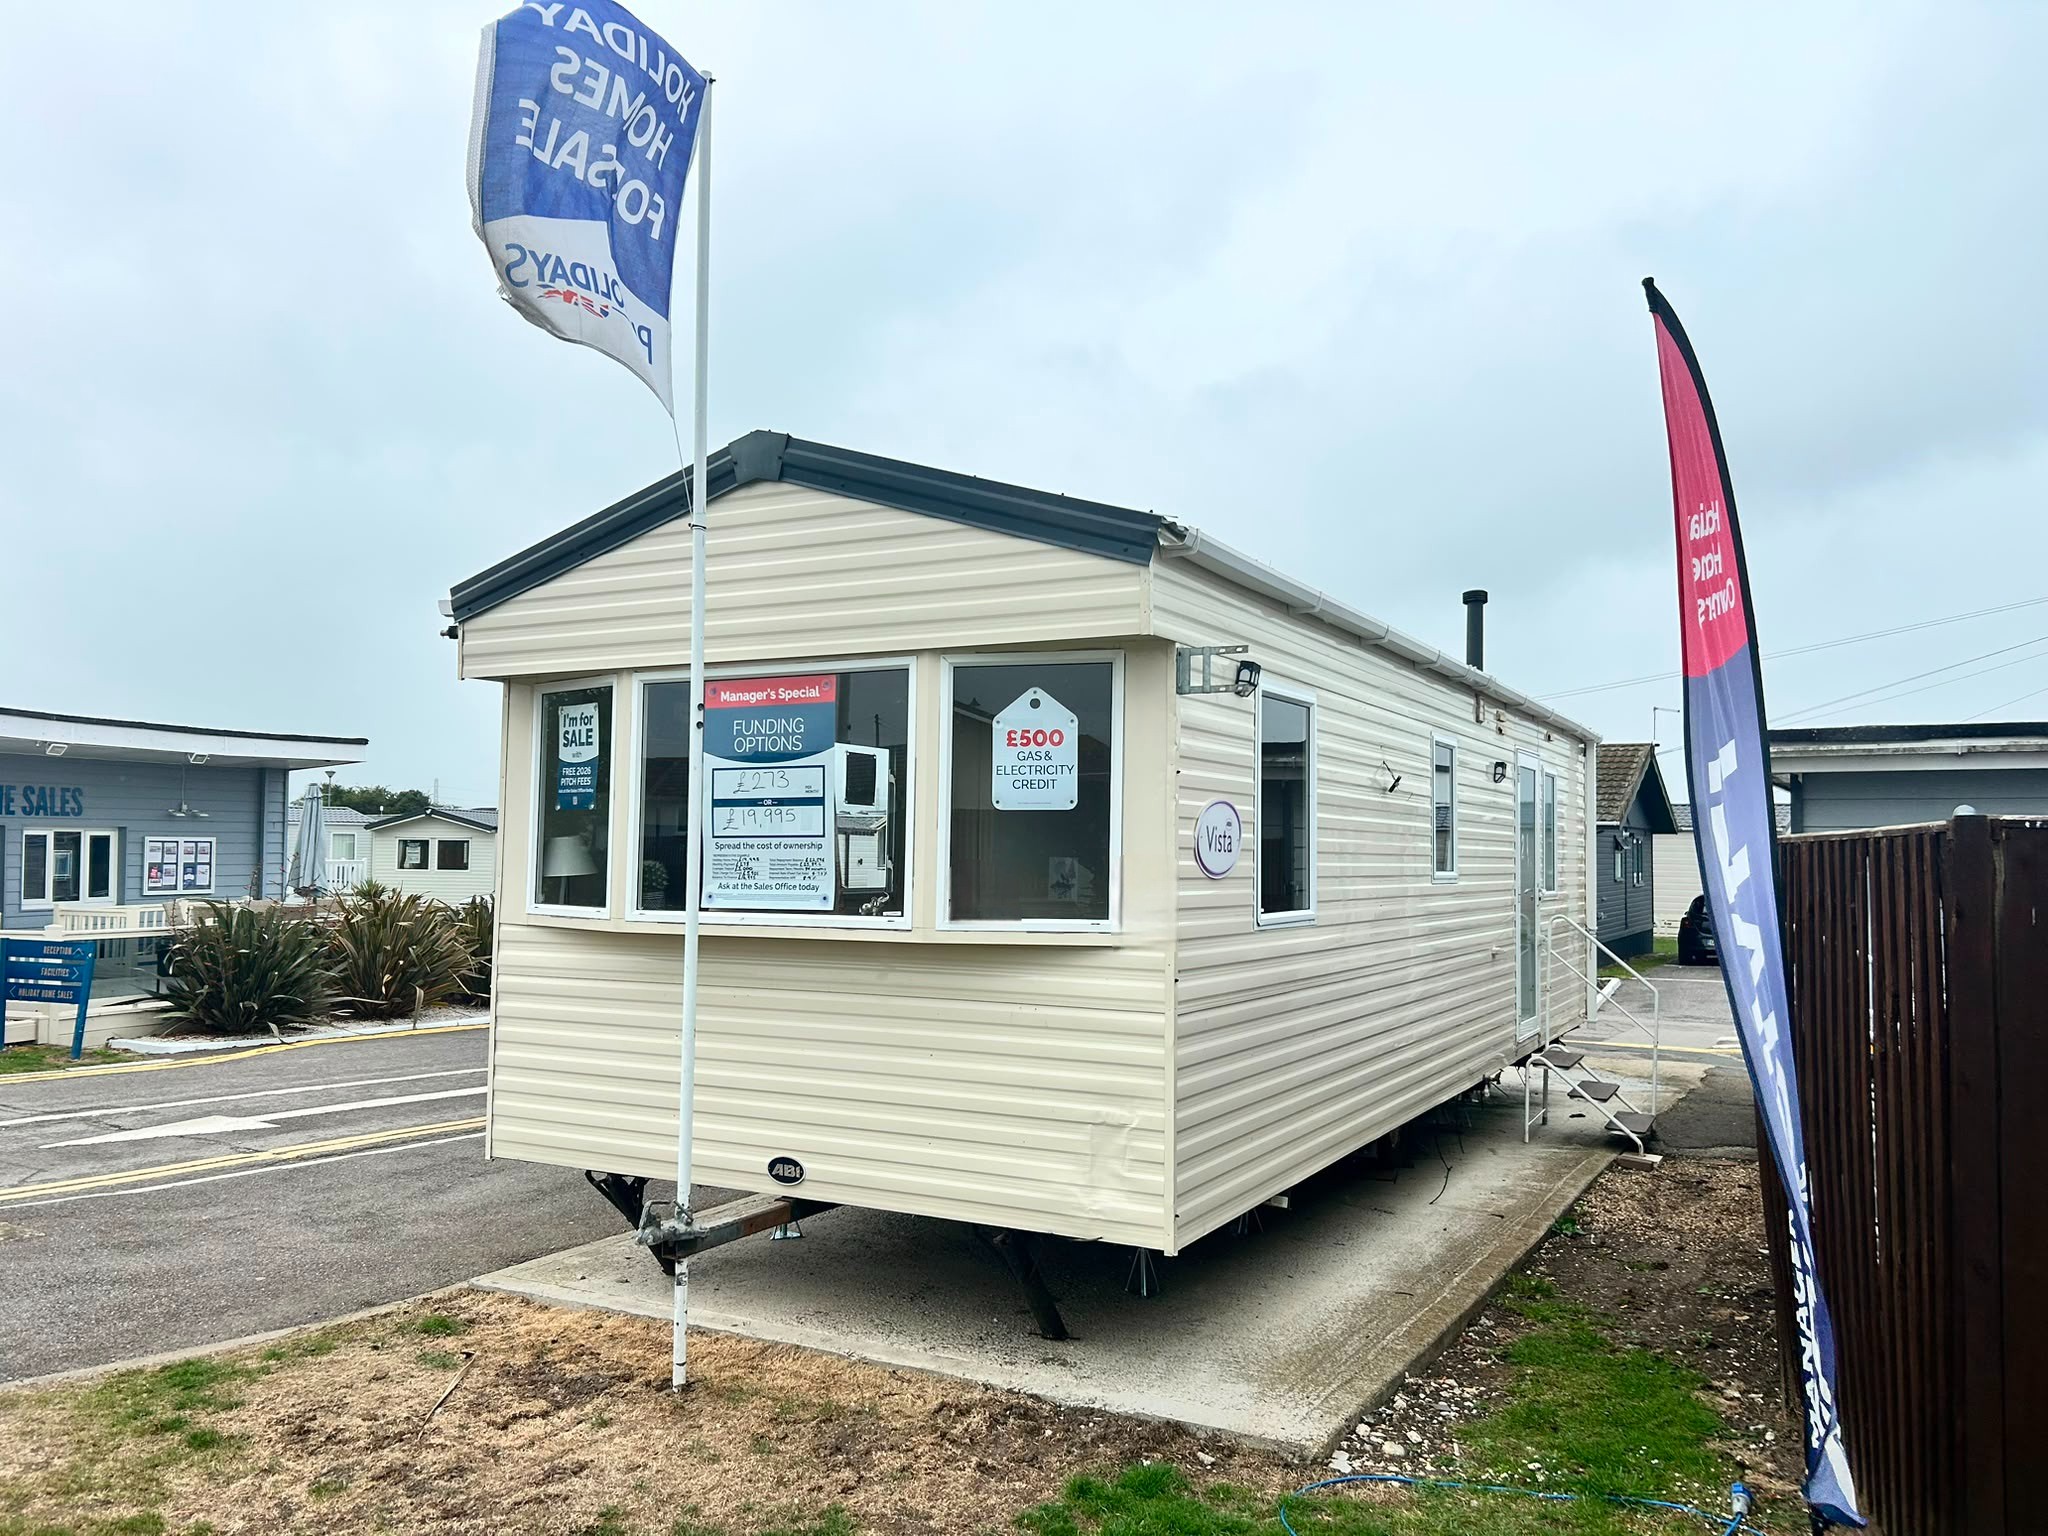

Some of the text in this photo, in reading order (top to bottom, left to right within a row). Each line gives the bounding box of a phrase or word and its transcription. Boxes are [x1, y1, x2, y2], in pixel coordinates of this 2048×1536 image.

[720, 686, 820, 704] Manager's Special
[563, 712, 594, 728] I'm for
[733, 717, 804, 735] FUNDING
[563, 728, 593, 747] SALE
[734, 735, 803, 753] OPTIONS
[1006, 729, 1065, 747] £500
[1017, 750, 1053, 761] GAS &
[562, 767, 576, 776] FREE
[996, 765, 1075, 775] ELECTRICITY
[560, 778, 576, 786] PITCH
[733, 770, 790, 794] £273
[1012, 779, 1058, 789] CREDIT
[21, 785, 83, 817] SALES
[723, 808, 797, 831] £19,995
[1206, 825, 1232, 853] Vista
[715, 842, 741, 851] Spread
[743, 842, 755, 850] the
[771, 842, 782, 850] of
[783, 842, 823, 851] ownership
[717, 882, 730, 890] Ask
[741, 882, 752, 890] the
[774, 883, 797, 891] Office
[798, 883, 820, 892] today
[43, 945, 72, 955] RECEPTION
[40, 967, 70, 977] FACILITIES
[18, 988, 40, 998] HOLIDAY
[57, 990, 73, 999] SALES
